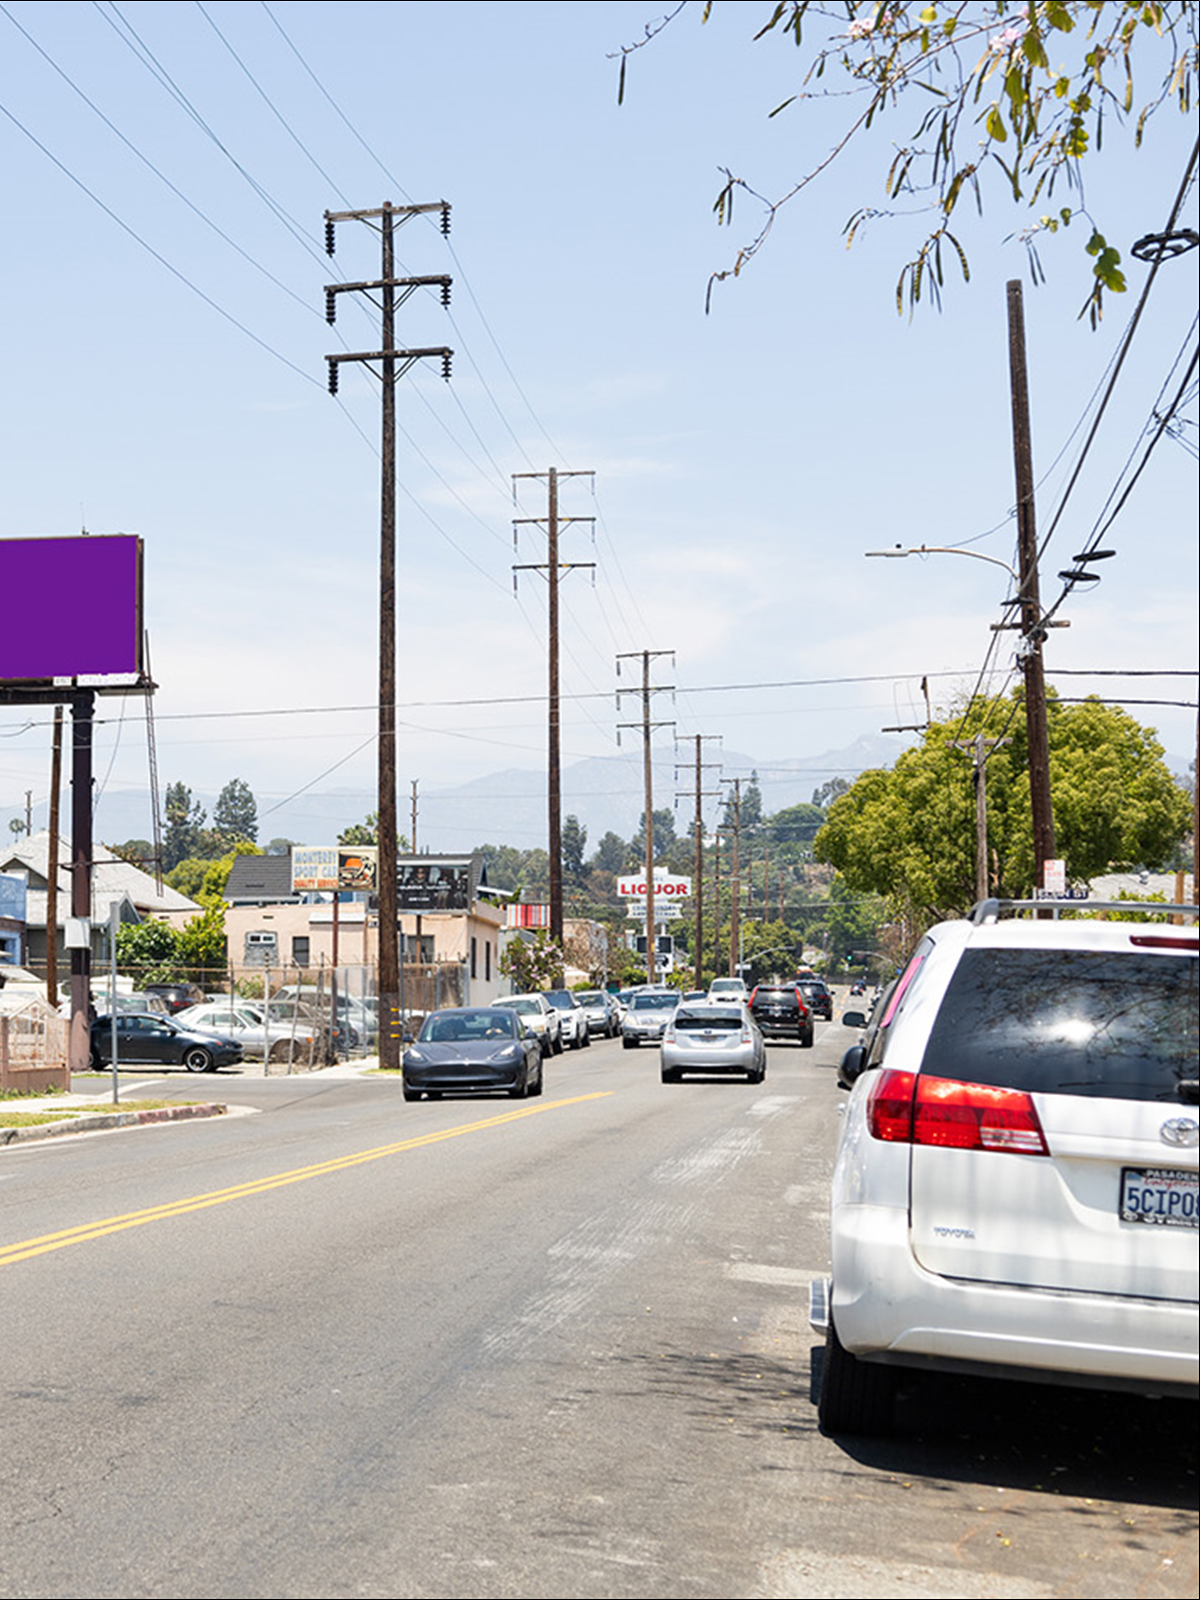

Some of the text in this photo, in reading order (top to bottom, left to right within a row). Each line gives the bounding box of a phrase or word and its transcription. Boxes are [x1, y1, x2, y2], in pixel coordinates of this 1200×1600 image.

[294, 850, 337, 864] MONTEREY
[294, 865, 337, 878] SPORT CAR
[293, 878, 316, 888] QUALITY
[620, 884, 687, 895] LIQUOR
